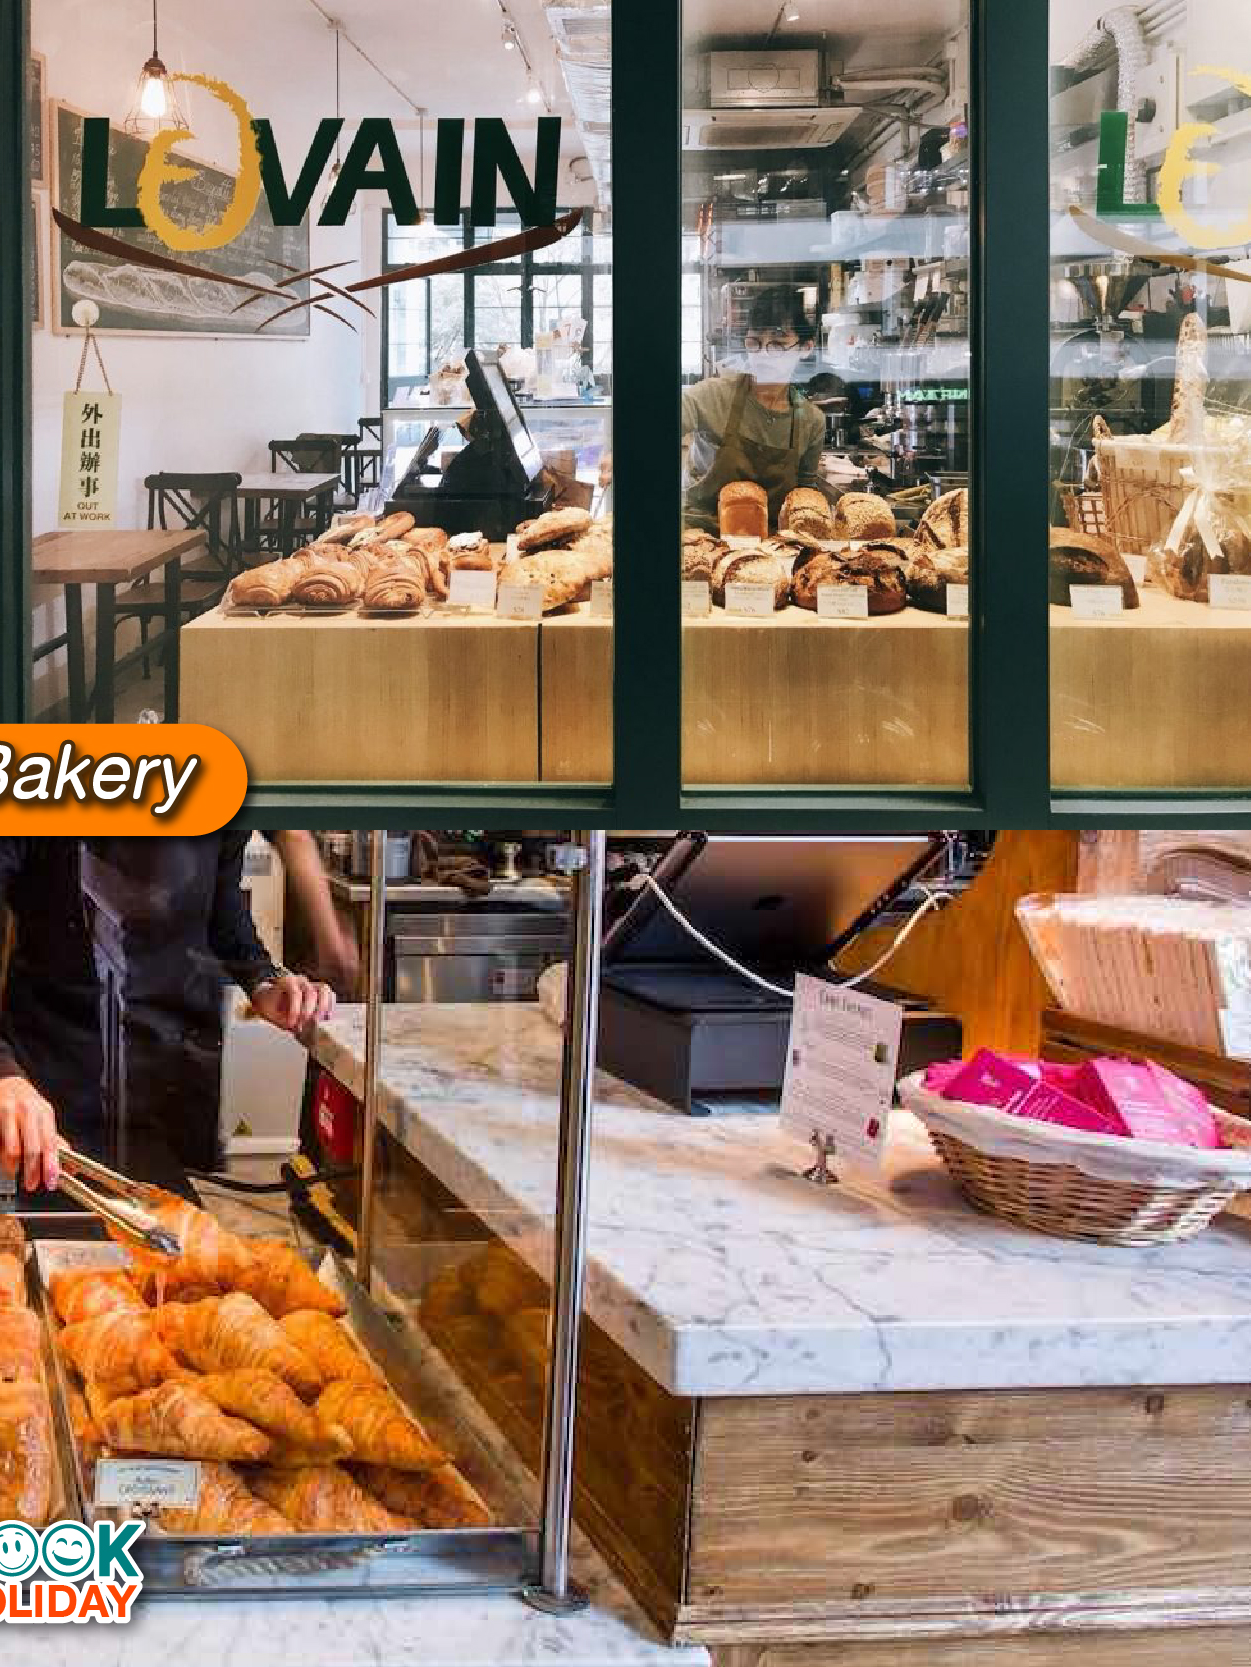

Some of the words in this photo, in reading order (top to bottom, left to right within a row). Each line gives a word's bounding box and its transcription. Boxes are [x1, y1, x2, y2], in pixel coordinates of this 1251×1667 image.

[78, 402, 104, 498] 外出辦事
[76, 501, 100, 511] OUT
[63, 512, 77, 521] AT
[79, 512, 111, 521] WORK
